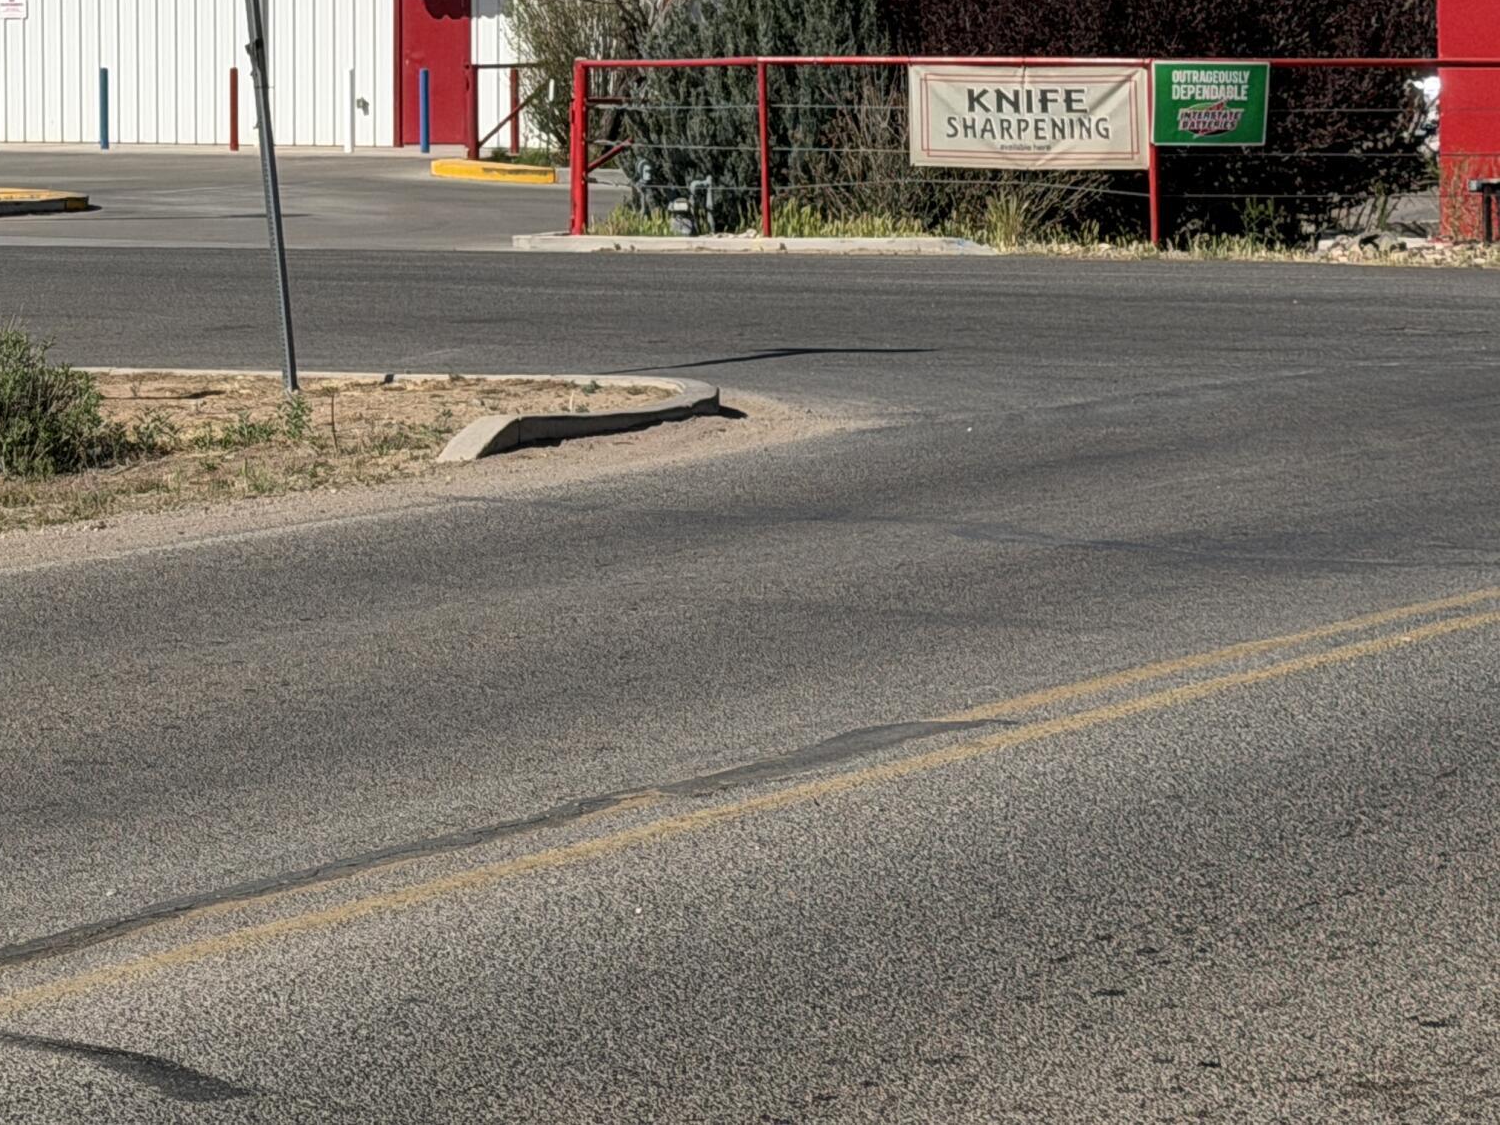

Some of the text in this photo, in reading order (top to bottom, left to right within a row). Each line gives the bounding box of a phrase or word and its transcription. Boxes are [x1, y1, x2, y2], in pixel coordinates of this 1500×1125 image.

[1171, 70, 1250, 84] OUTRAGEOUSLY
[967, 88, 1088, 113] KNIFE
[1171, 84, 1249, 101] DEPENDABLE
[946, 116, 1110, 139] SHARPENING
